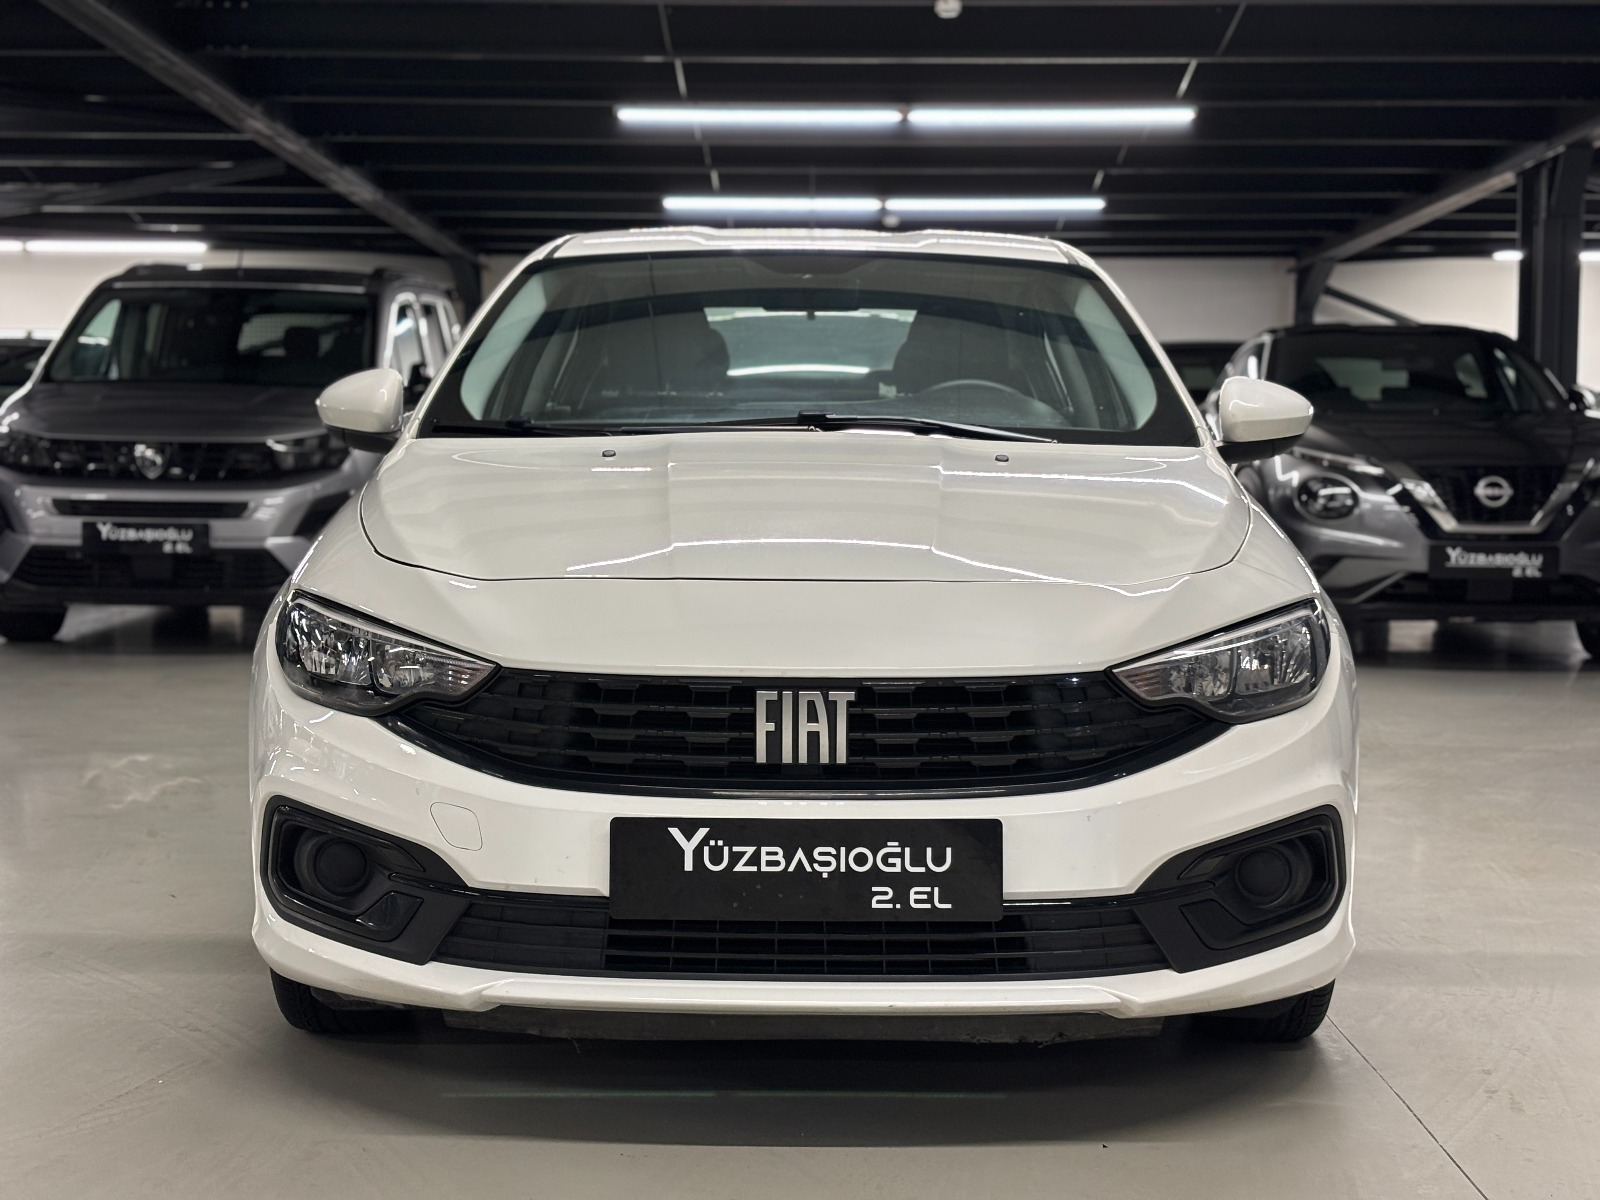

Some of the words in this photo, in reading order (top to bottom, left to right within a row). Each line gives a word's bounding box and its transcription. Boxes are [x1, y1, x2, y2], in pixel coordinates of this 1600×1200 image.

[755, 690, 856, 764] FIAT
[667, 827, 952, 878] YÜZBAŞIOĞLU
[871, 886, 901, 908] 2.
[909, 886, 952, 908] EL
